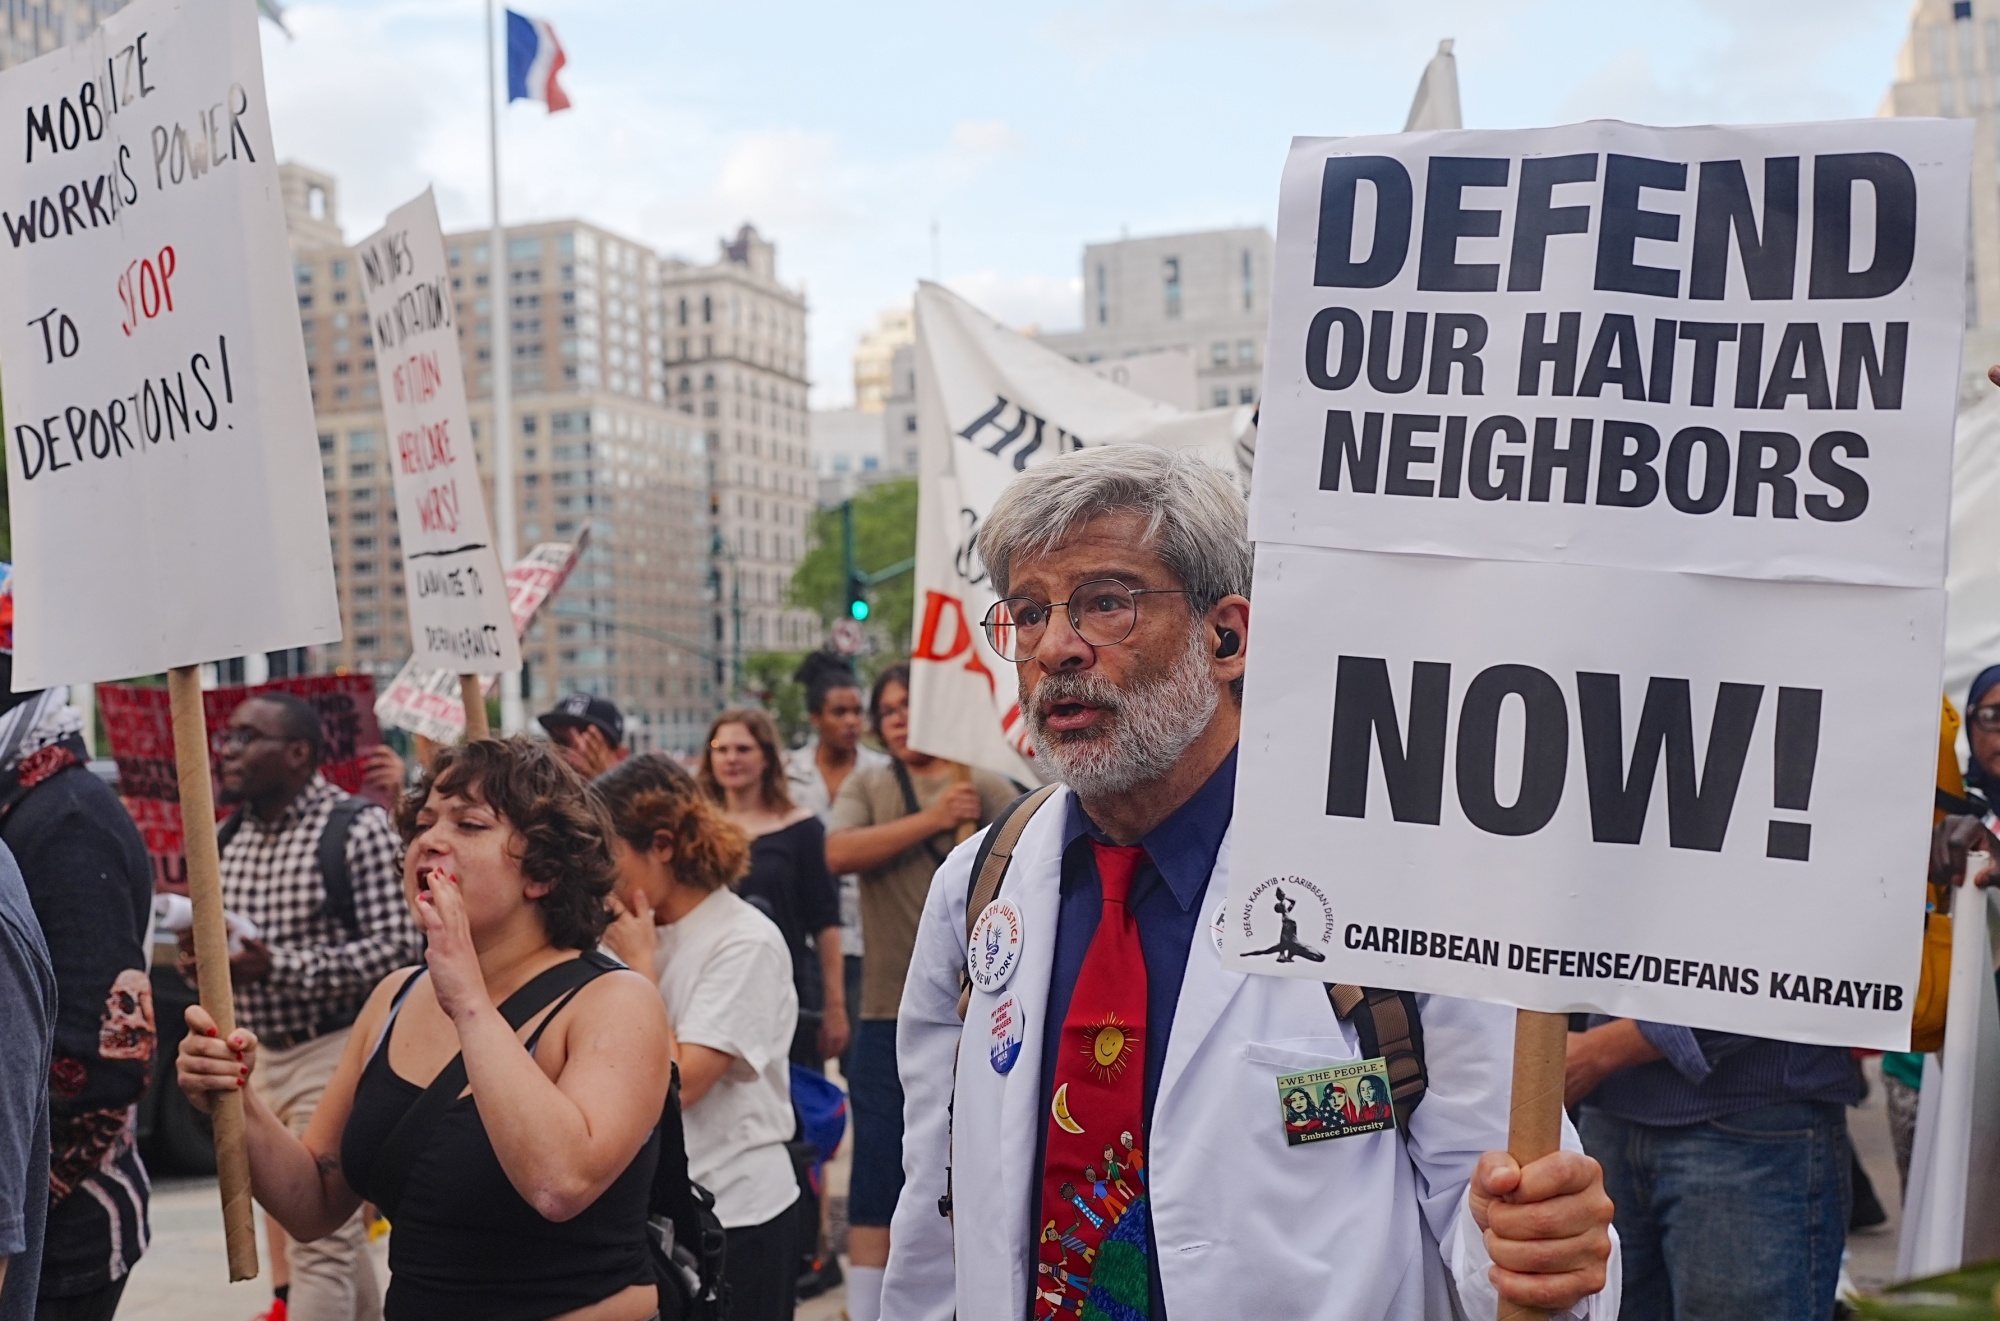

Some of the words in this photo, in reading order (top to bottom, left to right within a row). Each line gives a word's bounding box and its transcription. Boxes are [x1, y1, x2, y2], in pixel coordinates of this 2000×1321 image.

[151, 83, 256, 191] POWER
[1312, 151, 1917, 301] DEFEND
[27, 307, 80, 364] TO
[117, 245, 176, 337] STOP
[1305, 306, 1489, 396] OUR
[1517, 311, 1910, 410] HAITIAN
[1318, 409, 1870, 523] NEIGHBORS
[1325, 654, 1823, 862] NOW!
[1247, 876, 1279, 904] KARAYIB
[1288, 875, 1329, 907] CARIBBEAN
[1321, 907, 1334, 945] DEFENSE
[972, 904, 999, 942] HEALTH
[1000, 904, 1018, 945] JUSTICE
[975, 970, 992, 986] NEW
[994, 951, 1015, 981] YORK
[1344, 922, 1500, 967] CARIBBEAN
[1507, 943, 1761, 997] DEFENSE/DEFANS
[991, 1017, 1012, 1036] REFUGEES
[995, 1011, 1008, 1024] WERE
[997, 998, 1013, 1014] PEOPLE
[997, 1029, 1007, 1040] TOO
[1285, 1075, 1305, 1087] WE
[1307, 1070, 1331, 1083] THE
[1334, 1063, 1378, 1079] PEOPLE
[1300, 1129, 1341, 1142] Embrace
[1342, 1121, 1385, 1135] Diversity
